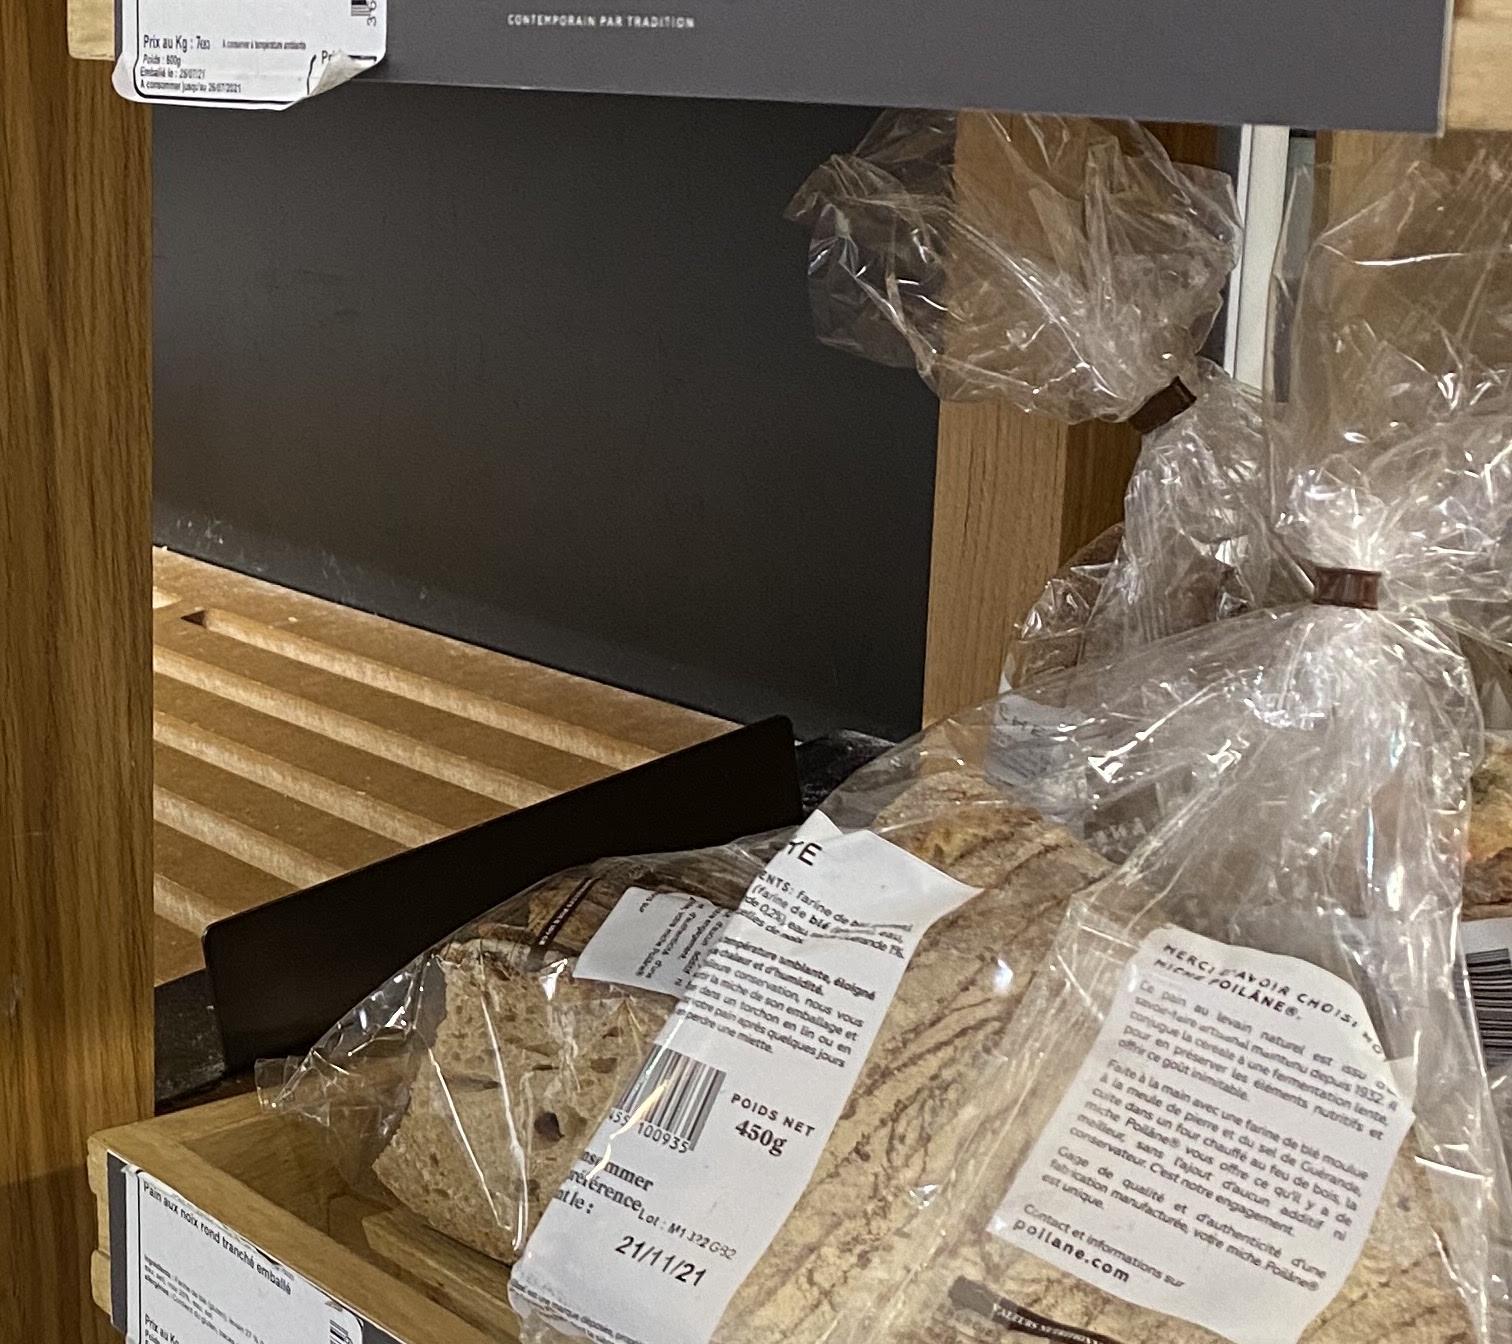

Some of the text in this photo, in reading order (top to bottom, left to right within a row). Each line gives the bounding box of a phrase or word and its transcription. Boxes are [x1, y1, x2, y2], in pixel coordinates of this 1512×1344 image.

[143, 35, 188, 53] Prix au Kg
[507, 13, 695, 29] CONTEMPORAIN PAR TRADITION
[789, 905, 806, 919] de
[796, 890, 832, 917] farine
[832, 913, 849, 925] de
[778, 956, 875, 1000] ambiante, éloigné
[1163, 944, 1215, 974] MERCI
[698, 986, 851, 1055] dans un torchon en lin ou en
[733, 969, 864, 1027] conservation, nous vous
[1138, 978, 1367, 1080] Ce pain au levain naturel est issu
[1117, 1039, 1247, 1101] offrir ce goût inimitable.
[1122, 1024, 1383, 1140] pour en préserver les éléments nutritifs et
[637, 1122, 692, 1153] 100935
[730, 1093, 815, 1136] POIDS NET
[735, 1120, 787, 1156] 450g
[1106, 1058, 1136, 1079] Faite
[1147, 1076, 1159, 1089] la
[1160, 1084, 1191, 1103] main
[1191, 1098, 1220, 1116] avec
[1220, 1110, 1243, 1126] une
[1244, 1118, 1280, 1143] farine
[1281, 1137, 1298, 1150] de
[1299, 1143, 1320, 1159] blé
[1321, 1154, 1368, 1180] moulue
[1076, 1114, 1346, 1241] meilleur, sans l'ajout d'aucun additif ni
[1084, 1101, 1120, 1122] miche
[1185, 1146, 1214, 1165] vous
[1219, 1162, 1249, 1180] offre
[1253, 1177, 1269, 1189] ce
[1273, 1186, 1301, 1204] qu'il
[1334, 1213, 1352, 1227] de
[1091, 1087, 1357, 1211] cuite dans un four chauffé au feu de bois, la
[1041, 1174, 1103, 1209] est unique.
[1069, 1127, 1293, 1236] conservateur. C'est notre engagement.
[143, 1179, 291, 1295] Pain aux noix rond tranché emballé
[637, 1207, 659, 1226] Lot
[1057, 1146, 1326, 1279] Gage de qualité et d'authenticité d'une
[615, 1235, 706, 1286] 21/11/21
[1012, 1219, 1129, 1282] poilane.com
[1023, 1203, 1184, 1287] Contact et informations sur
[144, 1313, 158, 1333] Prix
[159, 1328, 168, 1341] au
